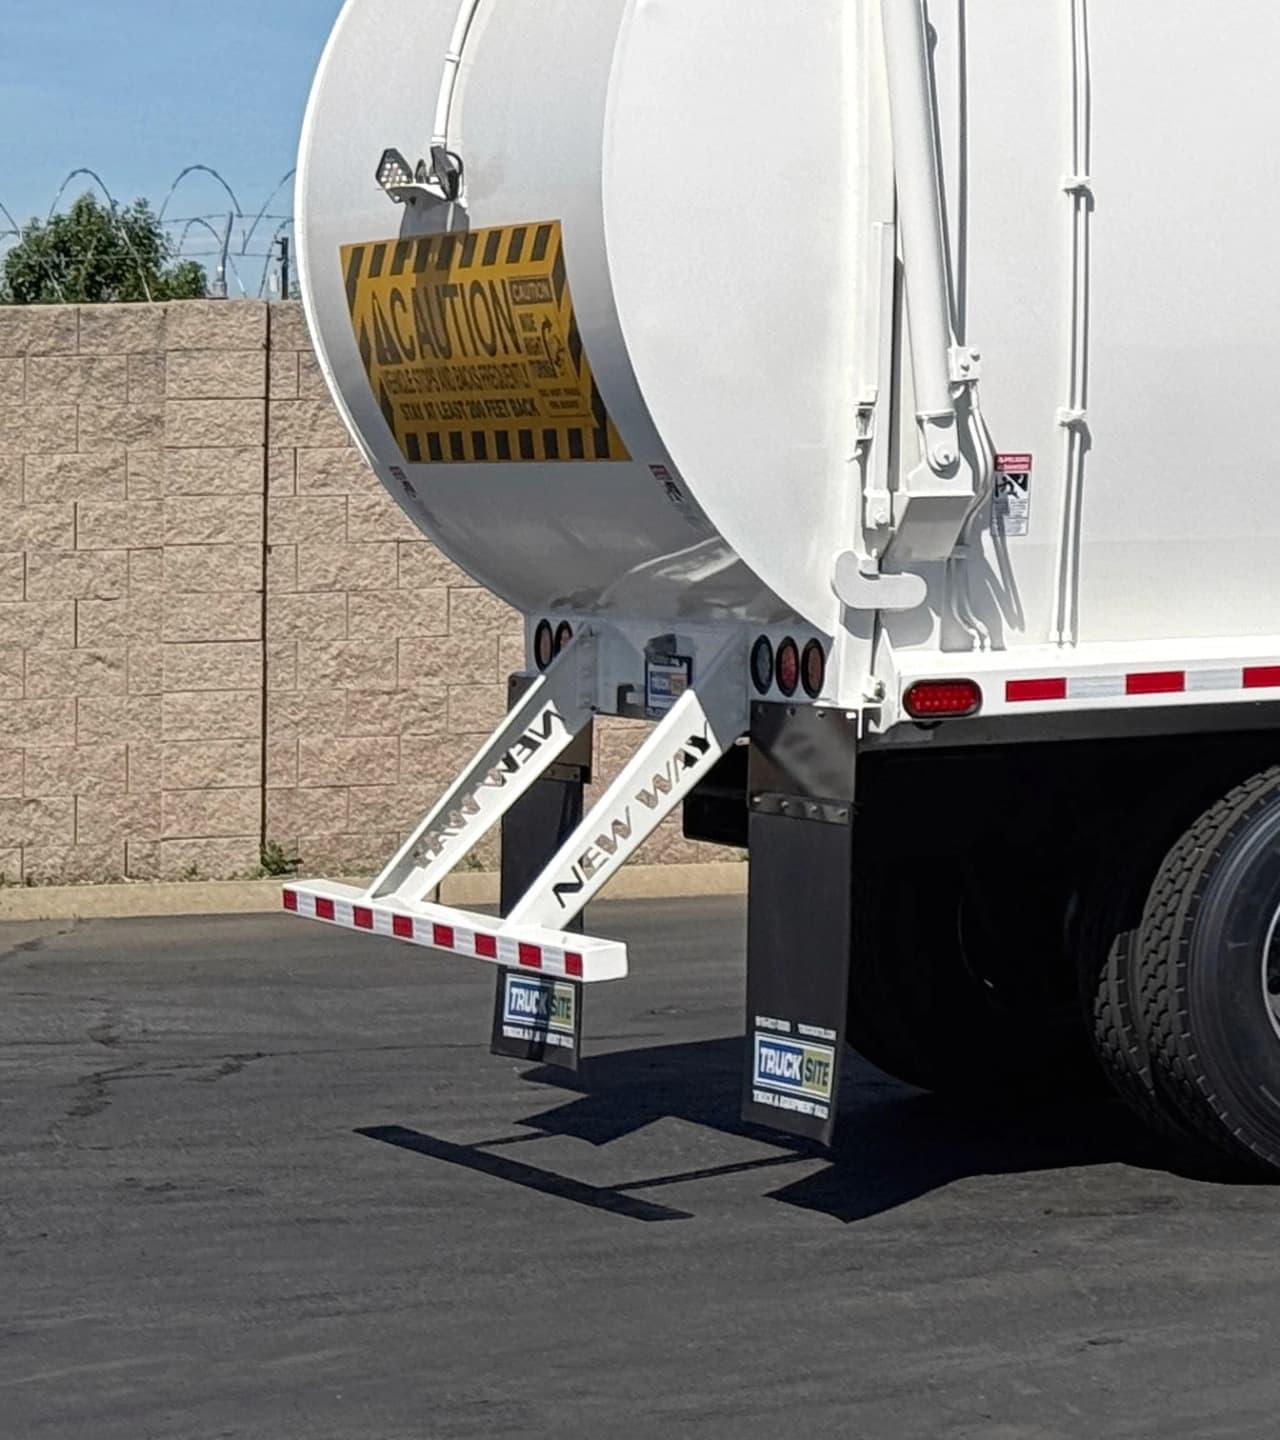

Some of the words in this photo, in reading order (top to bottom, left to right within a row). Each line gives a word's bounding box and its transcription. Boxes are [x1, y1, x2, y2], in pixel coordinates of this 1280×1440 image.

[391, 279, 522, 360] CAUTION
[437, 400, 468, 421] LEAST
[483, 398, 511, 419] FEET
[509, 397, 542, 418] BACK
[552, 804, 632, 909] NEW
[634, 719, 712, 810] WAY
[510, 988, 548, 1015] TRUCK
[550, 994, 572, 1019] SITE
[759, 1047, 803, 1081] TRUCK
[805, 1057, 831, 1087] SITE
